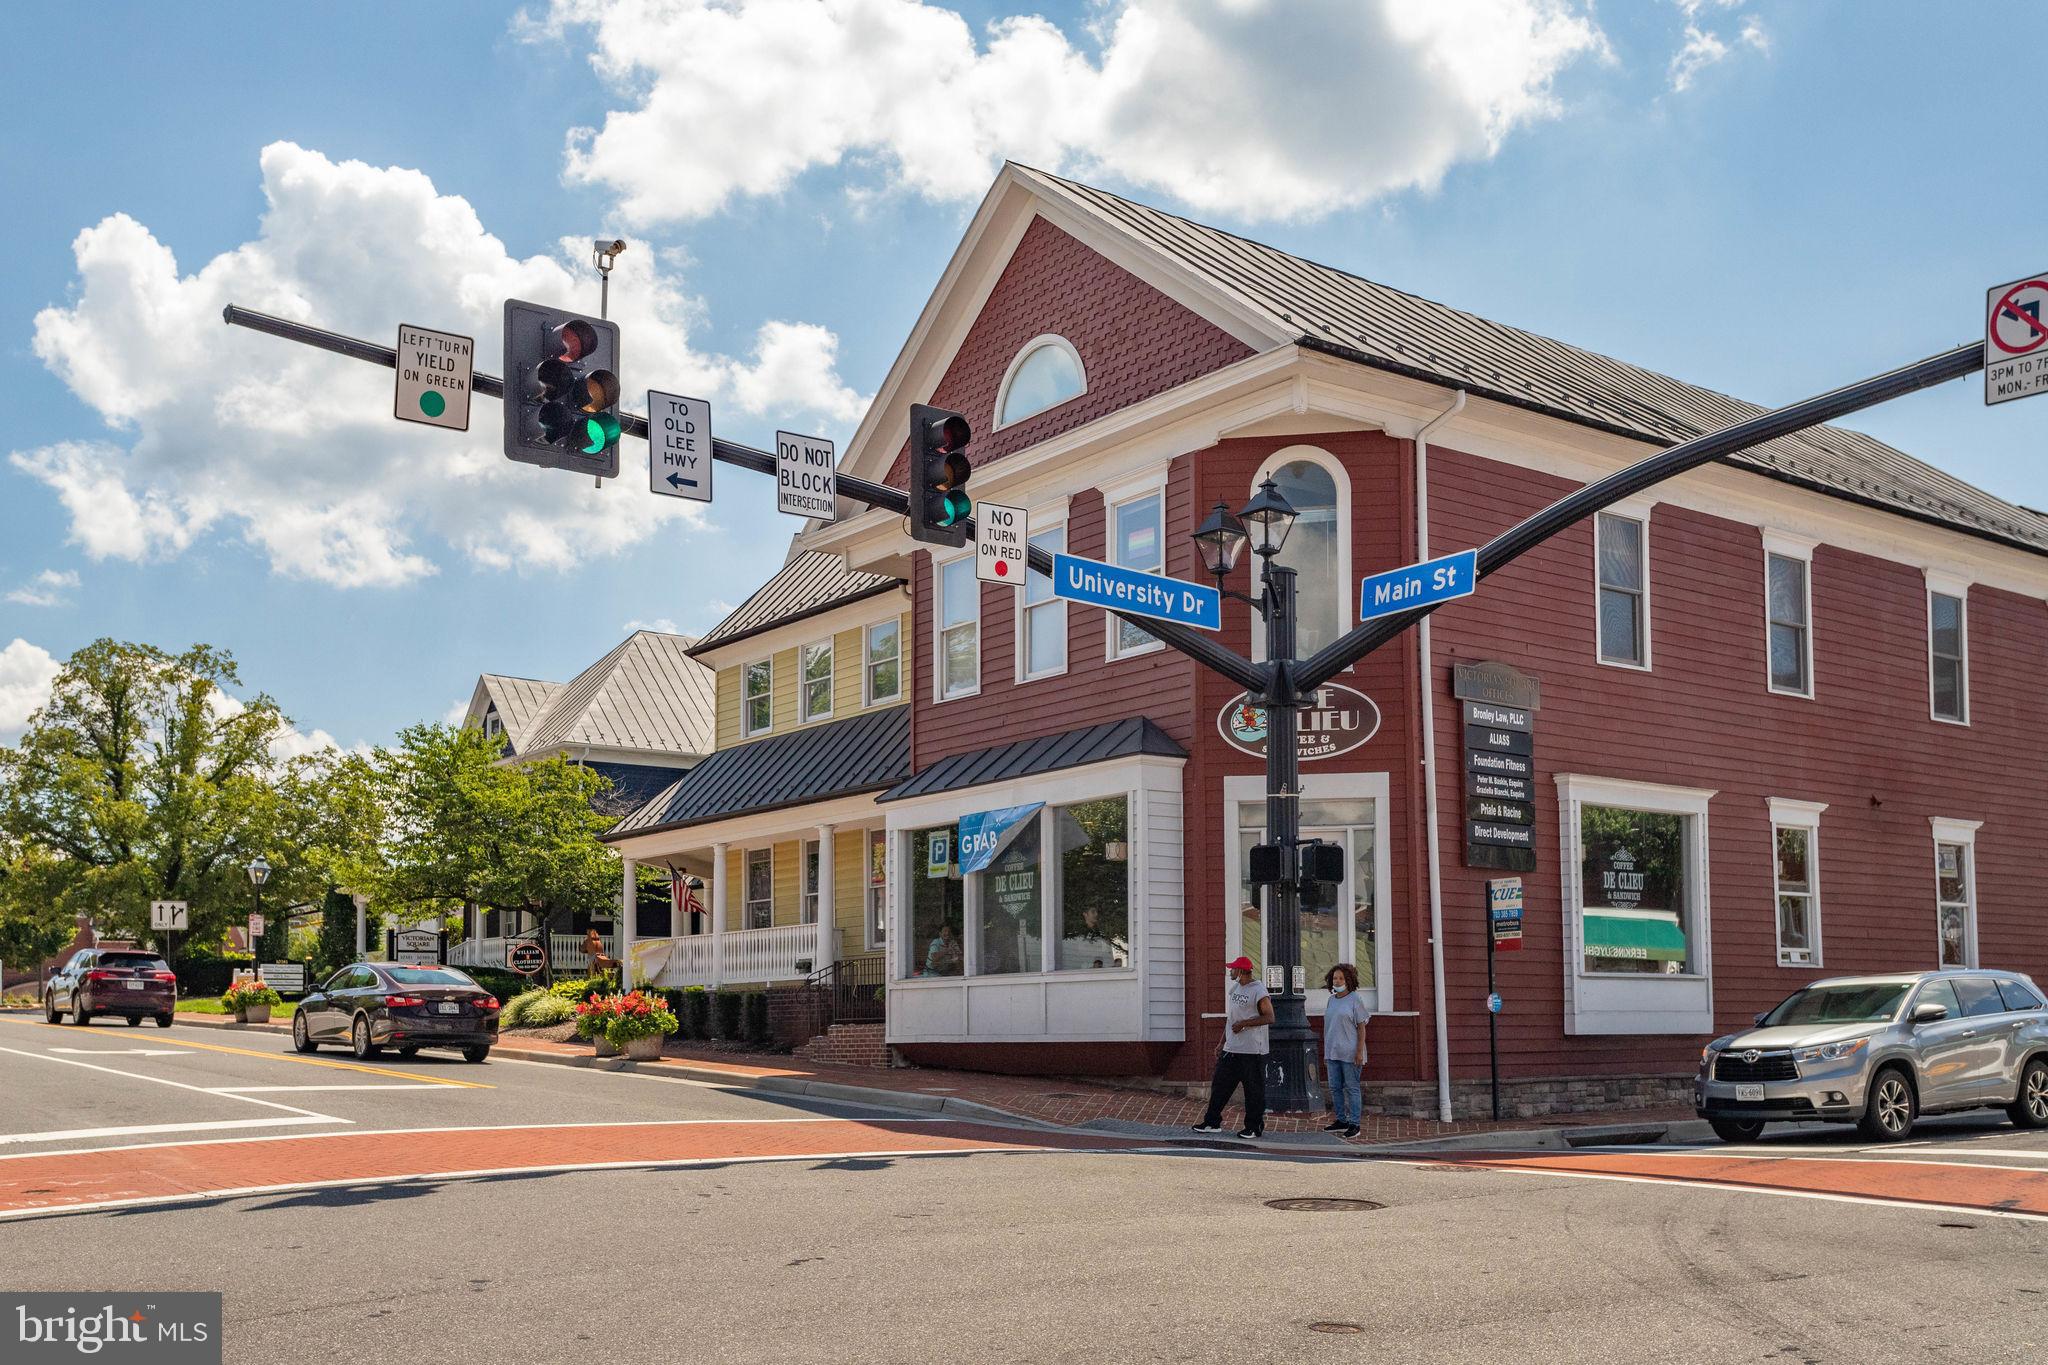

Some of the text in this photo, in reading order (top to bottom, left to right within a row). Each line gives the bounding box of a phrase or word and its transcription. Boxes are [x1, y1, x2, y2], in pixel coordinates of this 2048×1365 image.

[403, 333, 469, 356] LEFT TURN
[416, 351, 455, 372] YIELD
[404, 369, 464, 390] ON GREEN
[1991, 365, 2014, 381] 3PM
[2018, 361, 2032, 374] TO
[669, 401, 688, 416] TO
[665, 417, 695, 434] OLD
[666, 435, 695, 452] LEE
[664, 451, 698, 469] HWY
[780, 442, 831, 468] DO NOT
[781, 468, 832, 495] BLOCK
[781, 491, 832, 513] INTERSECTION
[992, 510, 1013, 526] NO
[988, 527, 1016, 543] TURN
[981, 543, 1022, 560] ON RED
[1069, 565, 1204, 615] University Dr
[1374, 565, 1457, 606] Main St
[1495, 710, 1509, 725] Law,
[1510, 713, 1524, 726] PLLC
[1489, 733, 1510, 746] ALIASS
[1474, 754, 1526, 772] Foundation Fitness
[1497, 805, 1502, 817] &
[1503, 805, 1521, 819] Racine
[962, 830, 998, 854] GRAB
[1474, 825, 1529, 843] Direct Development
[1004, 862, 1025, 872] COFFEE
[1613, 861, 1634, 870] COFFEE
[995, 872, 1034, 893] DE CLIEU
[1603, 871, 1644, 890] DE CLIEU
[1004, 891, 1031, 902] SANDWICH
[1493, 888, 1517, 900] CUE
[1607, 891, 1641, 901] & SANDWICH
